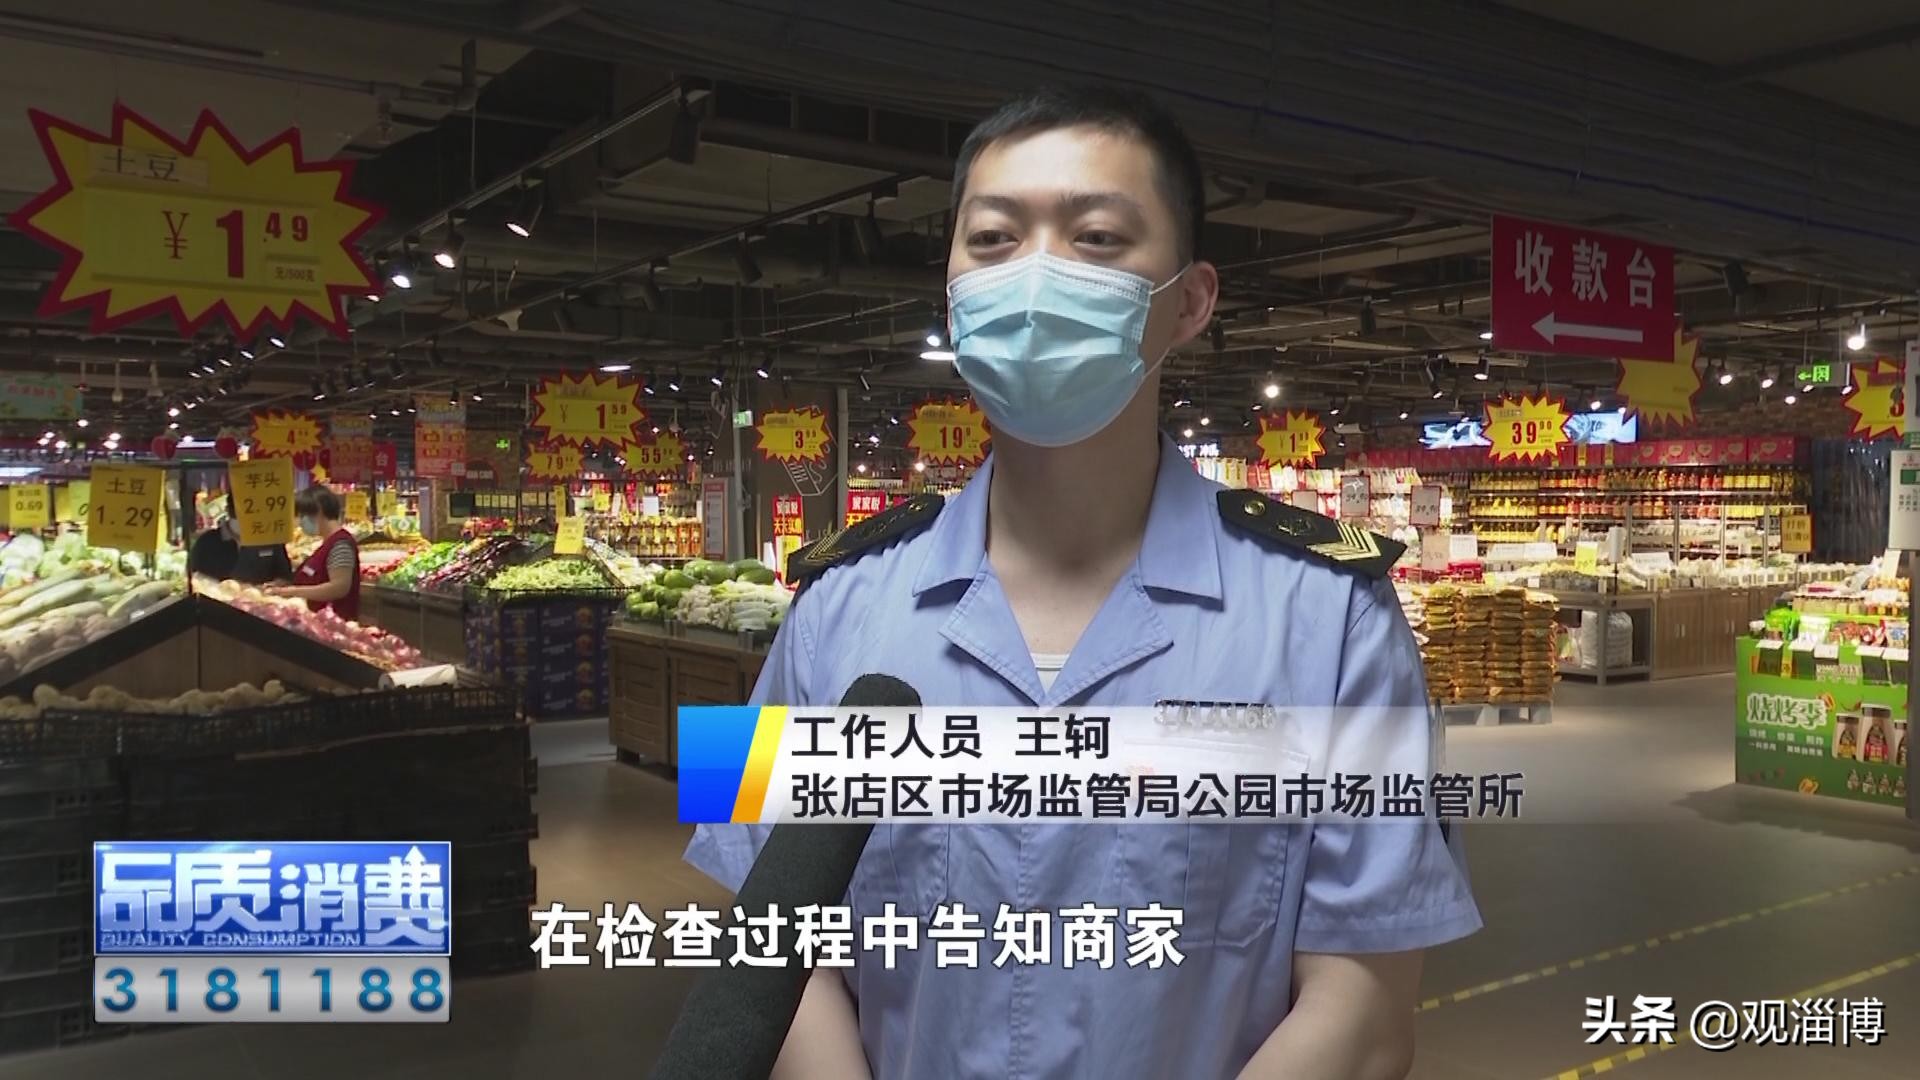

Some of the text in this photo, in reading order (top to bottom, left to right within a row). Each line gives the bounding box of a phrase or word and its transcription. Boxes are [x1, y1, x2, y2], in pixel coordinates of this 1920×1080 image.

[100, 147, 180, 183] 土豆
[1515, 230, 1657, 309] 收款台
[106, 477, 147, 496] 土豆
[244, 472, 281, 489] 芋头
[243, 495, 287, 514] 2.99
[96, 505, 154, 528] 1.29
[252, 519, 286, 536] 元/斤
[1747, 693, 1827, 730] 烧烤季
